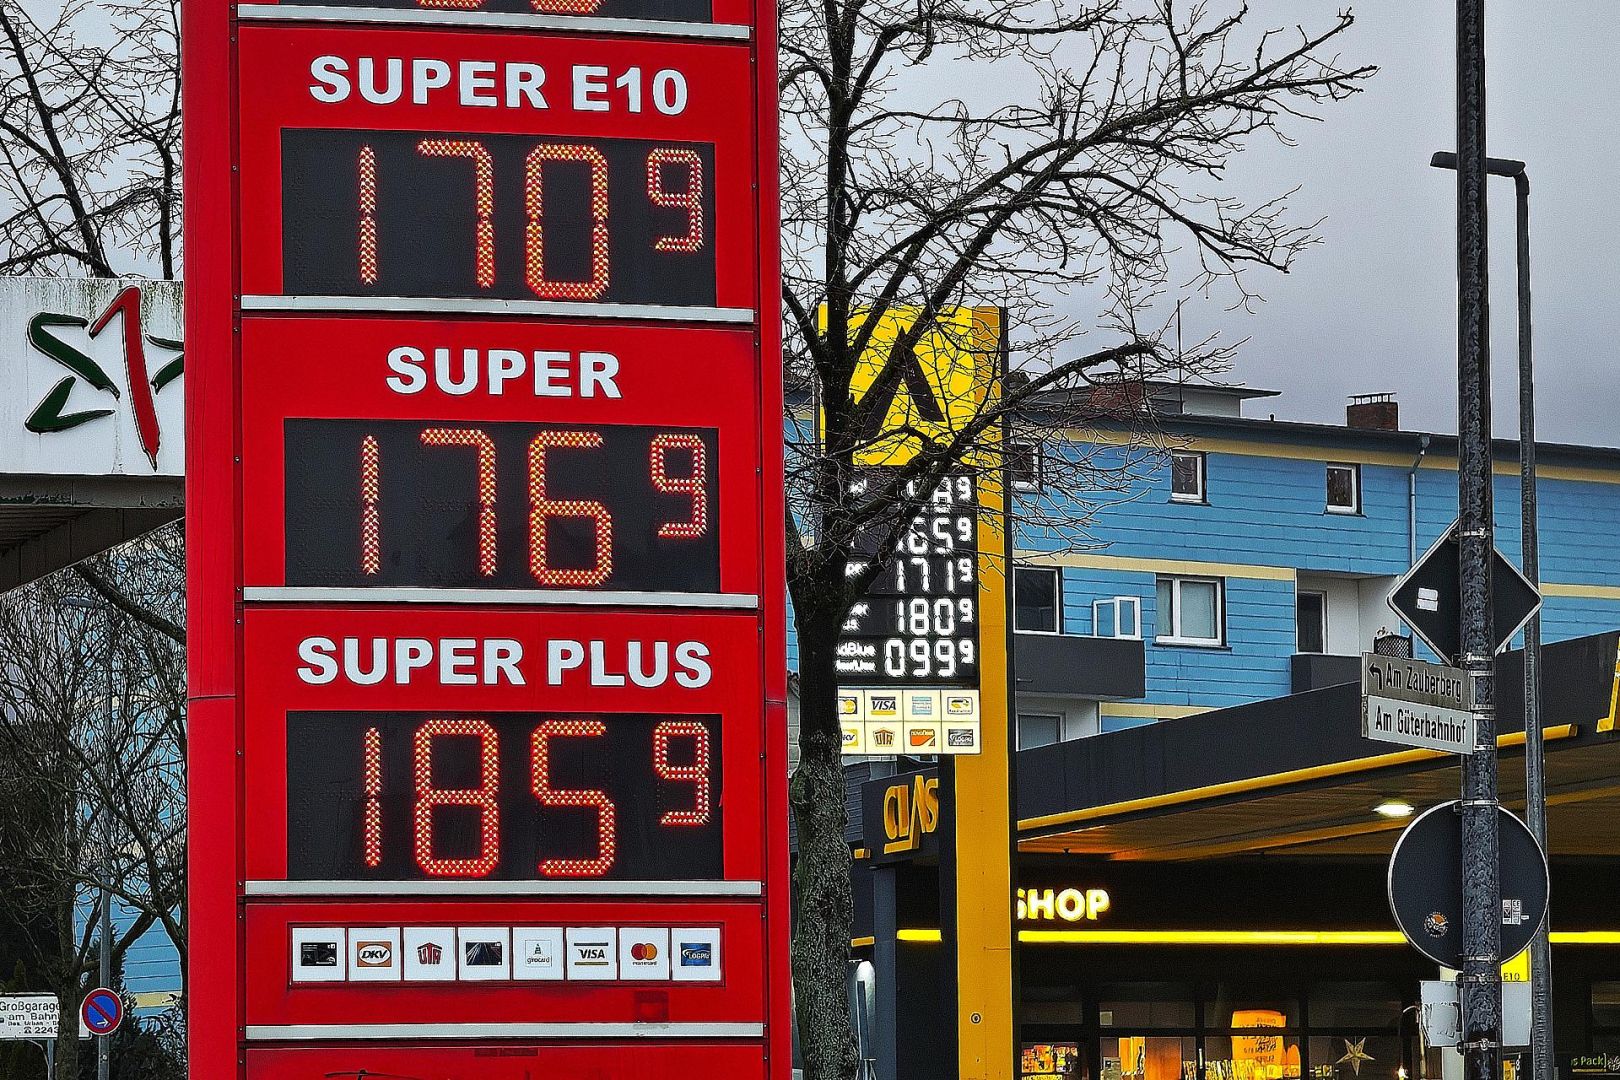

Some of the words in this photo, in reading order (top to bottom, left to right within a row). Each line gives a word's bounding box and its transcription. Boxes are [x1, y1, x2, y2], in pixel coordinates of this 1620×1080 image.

[308, 55, 549, 110] SUPER
[571, 64, 689, 116] E10
[385, 346, 621, 400] SUPER
[297, 636, 526, 687] SUPER
[546, 639, 712, 690] PLUS
[1386, 662, 1403, 688] Am
[1406, 665, 1462, 703] Zauberberg
[872, 700, 896, 711] VISA
[1375, 705, 1392, 732] Am
[1397, 708, 1467, 743] Güterbahnhof
[361, 949, 388, 960] DKV
[578, 948, 606, 959] VISA
[8, 1013, 25, 1021] am
[30, 1012, 60, 1021] Bahn
